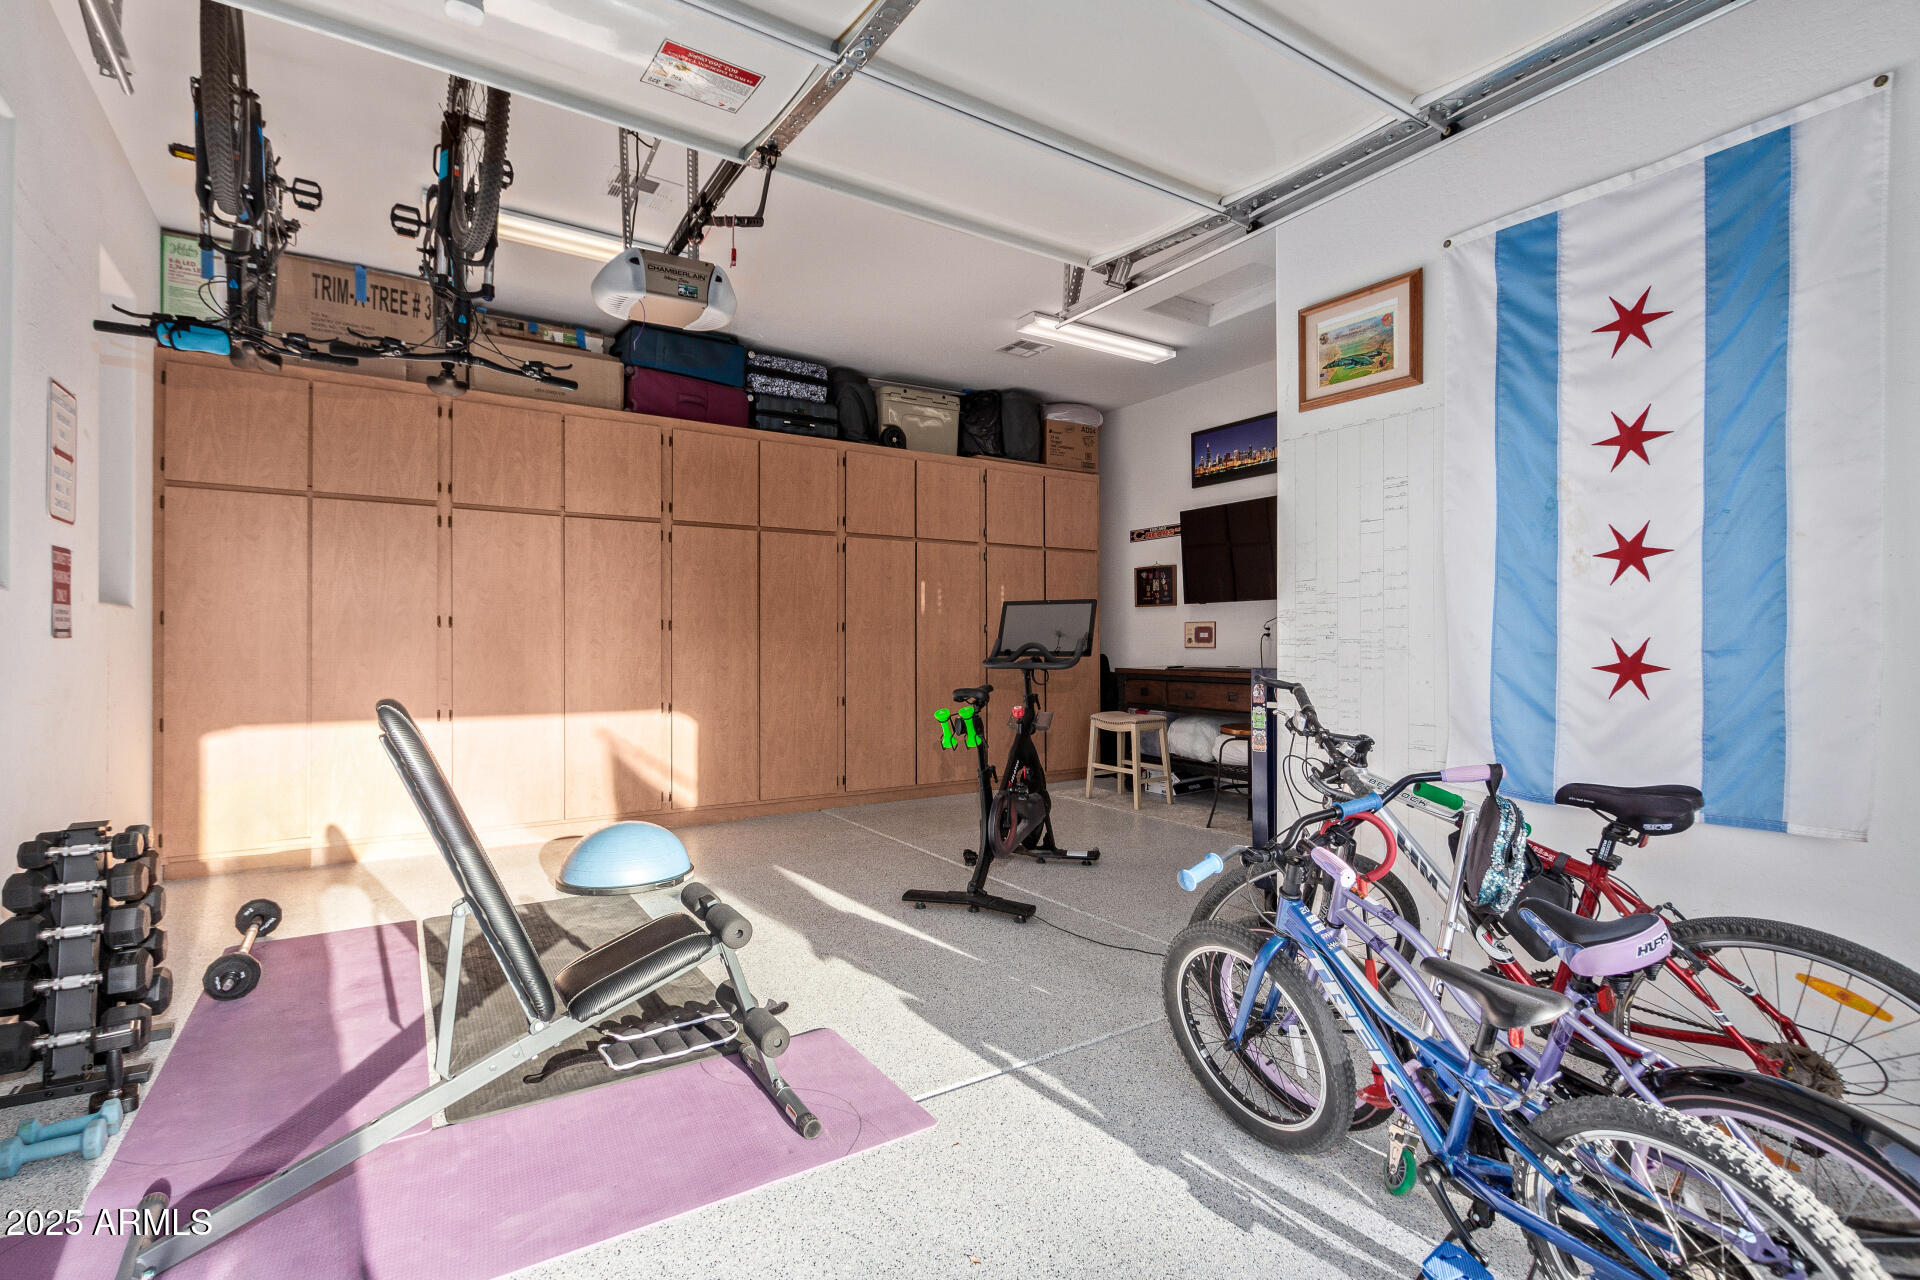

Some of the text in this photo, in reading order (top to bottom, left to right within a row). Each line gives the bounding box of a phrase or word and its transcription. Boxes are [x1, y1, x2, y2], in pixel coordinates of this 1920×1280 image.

[647, 264, 706, 281] CHAMBERLAIN
[312, 272, 432, 320] TRIM--TREE # 3
[1368, 777, 1427, 807] BEDOCK
[1308, 949, 1407, 1091] TREK
